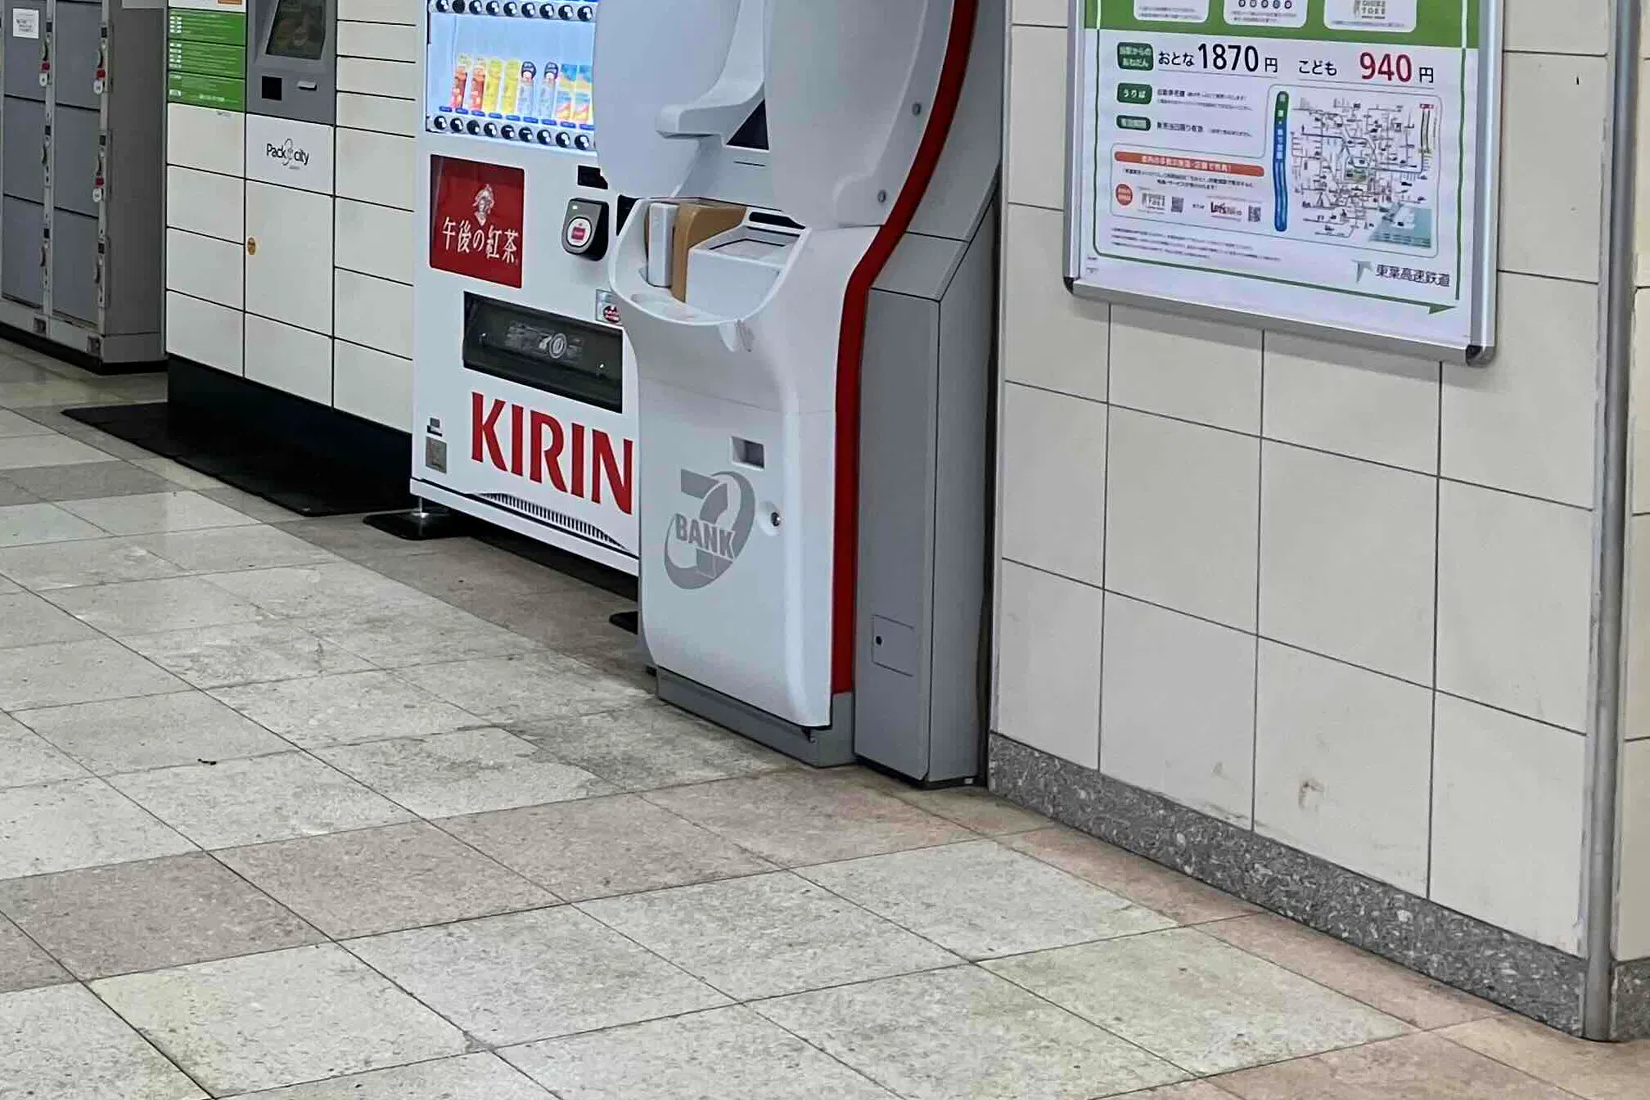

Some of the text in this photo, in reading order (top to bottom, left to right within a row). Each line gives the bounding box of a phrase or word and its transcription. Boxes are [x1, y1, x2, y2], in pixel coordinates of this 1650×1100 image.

[1158, 42, 1278, 73] おとな 1870 円
[1298, 51, 1434, 84] こども 940 円
[266, 142, 309, 166] Pack city
[442, 216, 519, 263] 午後の紅茶
[471, 392, 634, 515] KIRIN
[675, 512, 736, 559] BANK
